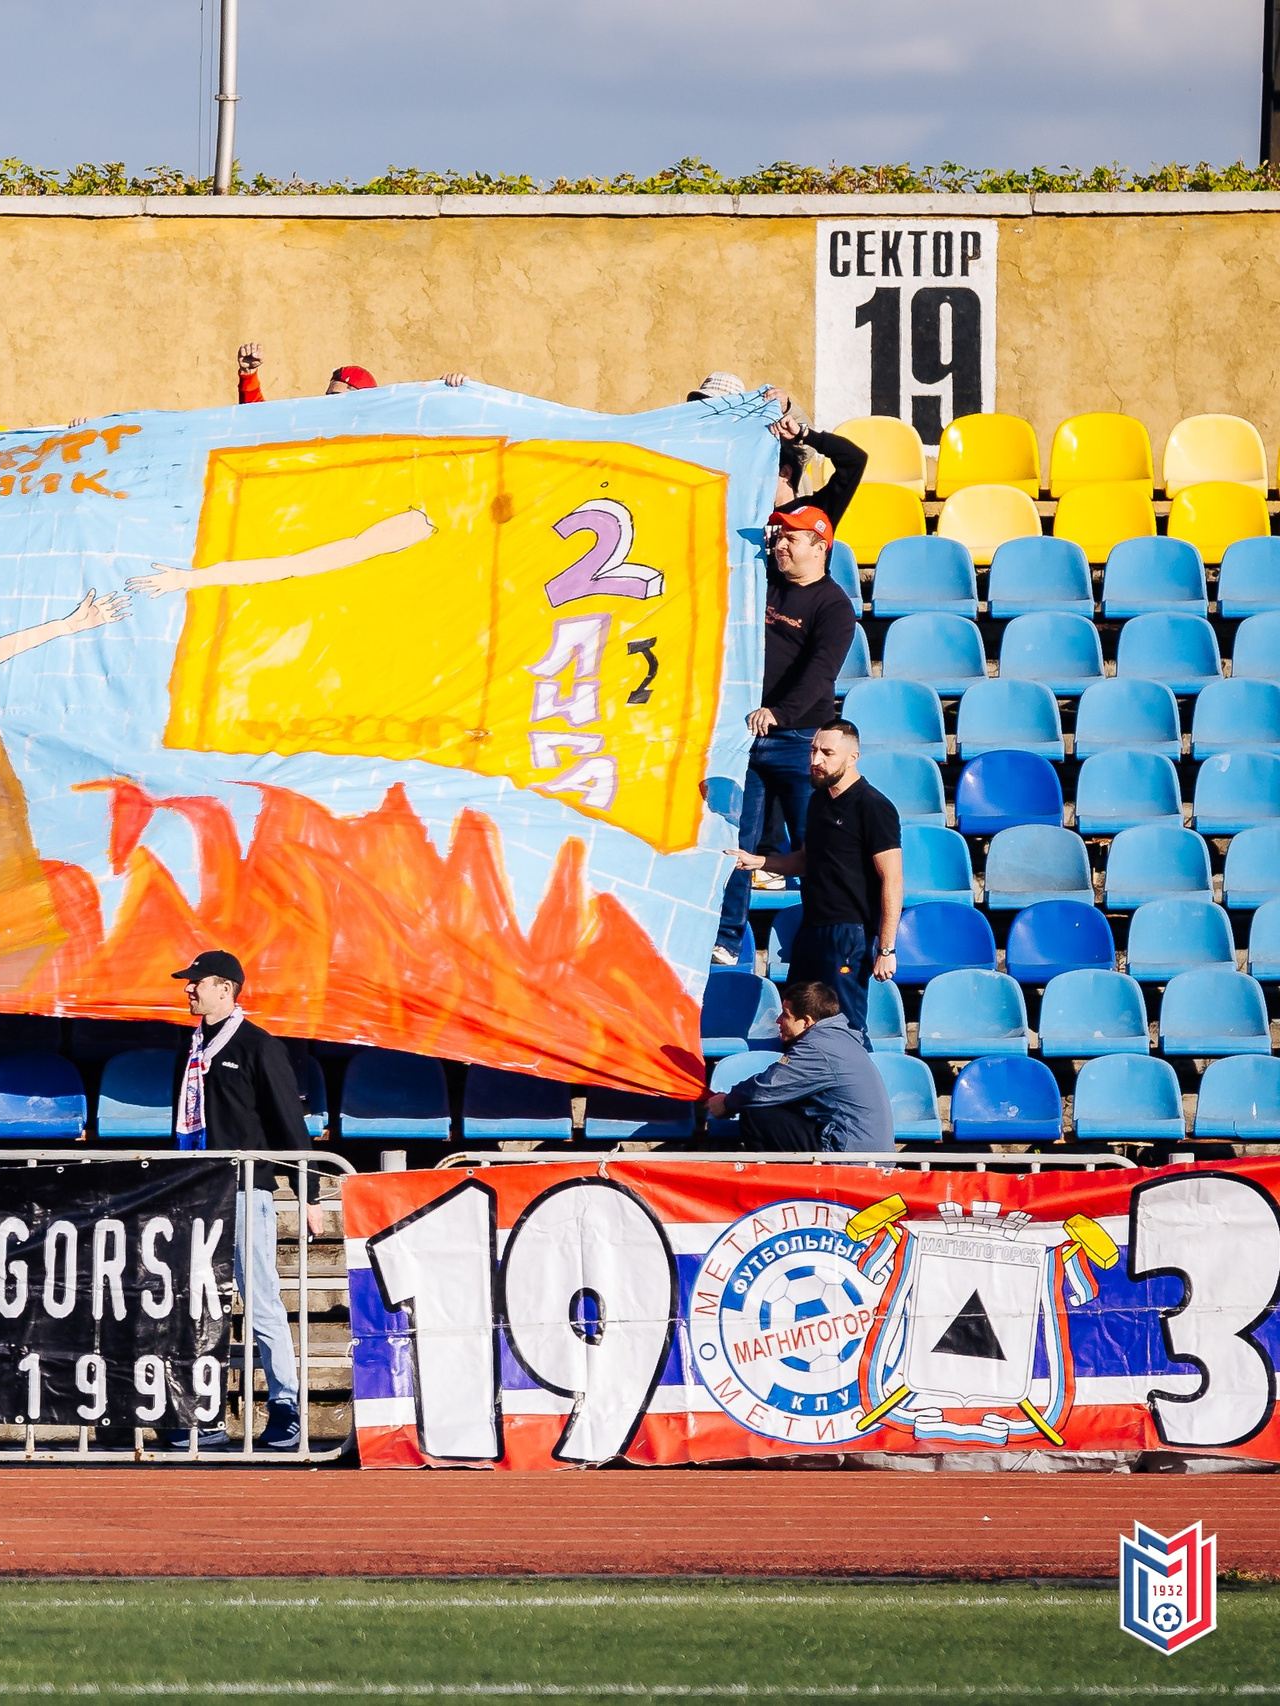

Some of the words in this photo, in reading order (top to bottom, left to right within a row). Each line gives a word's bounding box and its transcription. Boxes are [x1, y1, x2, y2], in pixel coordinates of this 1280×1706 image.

[829, 230, 982, 277] СЕКТОР
[855, 286, 983, 446] 19
[544, 497, 666, 609] 2
[921, 1236, 1042, 1265] МАГНИТОГОРСК
[17, 1354, 221, 1422] 1999
[791, 1389, 850, 1412] КЛУ
